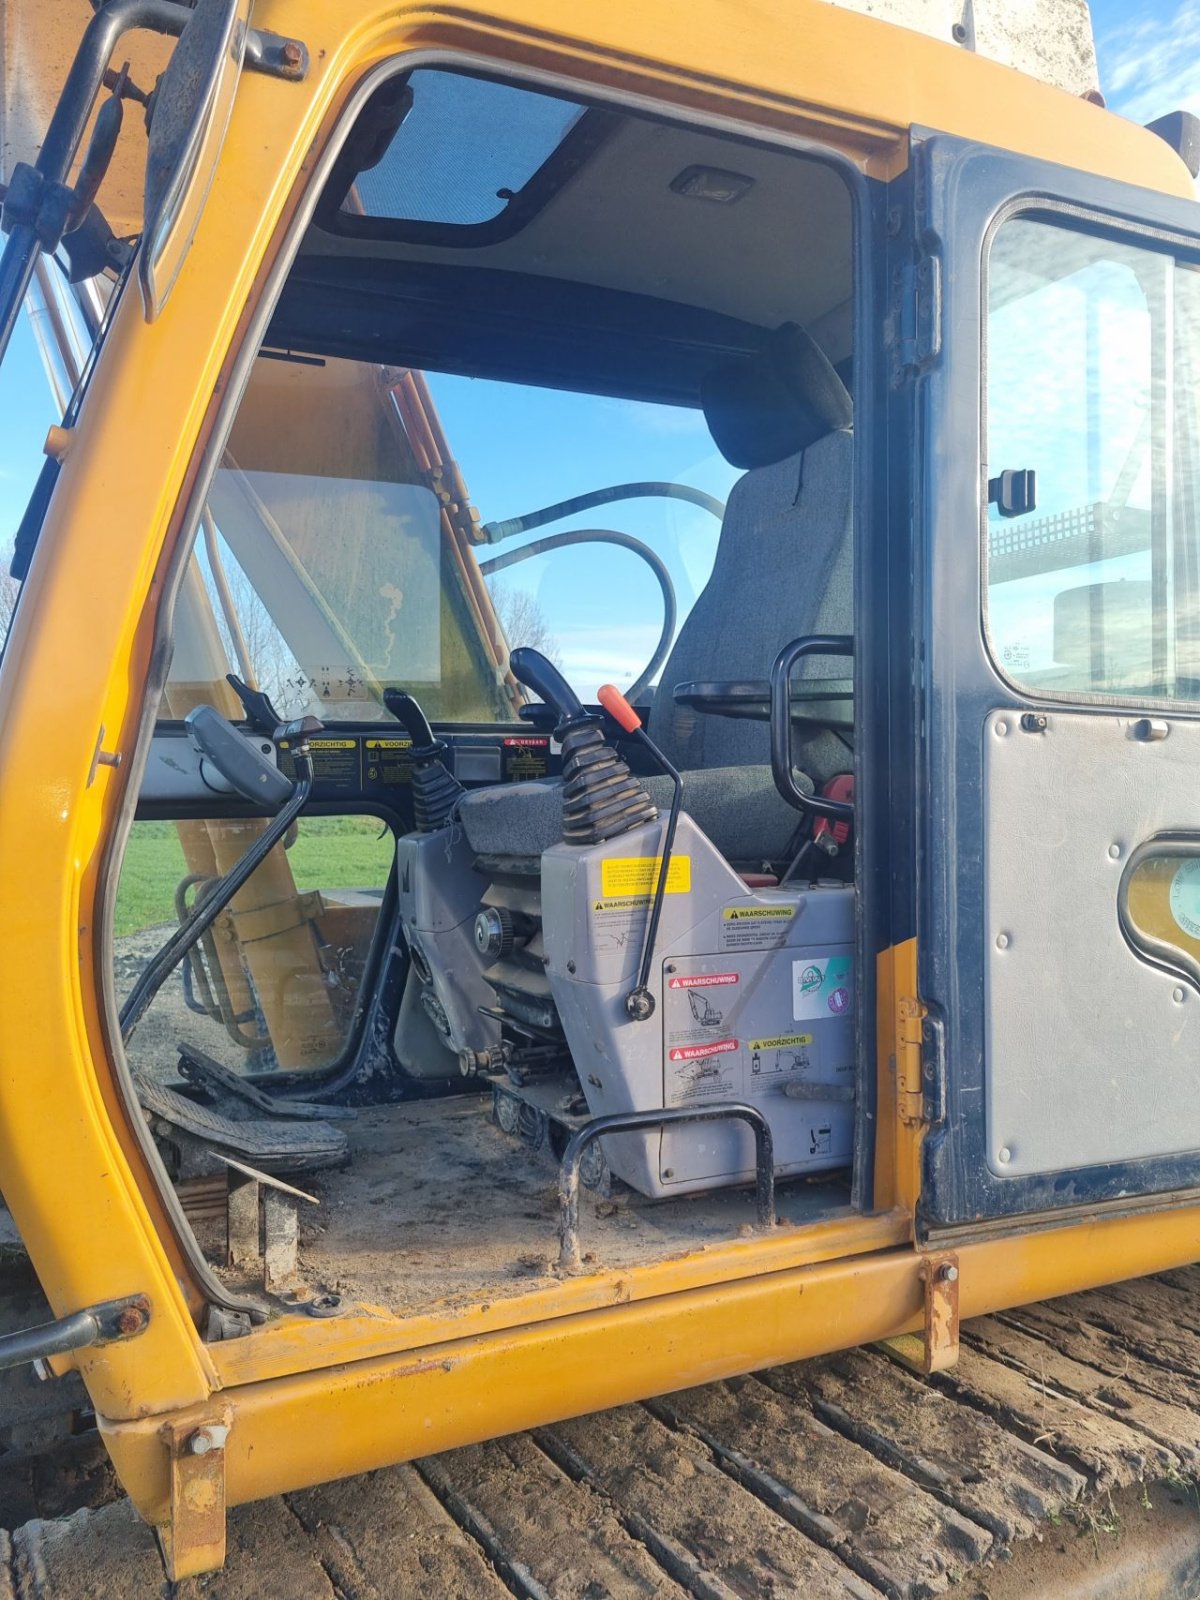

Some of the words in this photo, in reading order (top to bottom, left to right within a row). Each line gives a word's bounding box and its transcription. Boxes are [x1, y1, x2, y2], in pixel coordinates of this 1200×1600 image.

[739, 909, 792, 918] WAARSCHUWING
[682, 975, 736, 987] WAARSCHUWING
[762, 1036, 806, 1047] VOORZICHTIG
[683, 1042, 736, 1058] WAARSCHUWING
